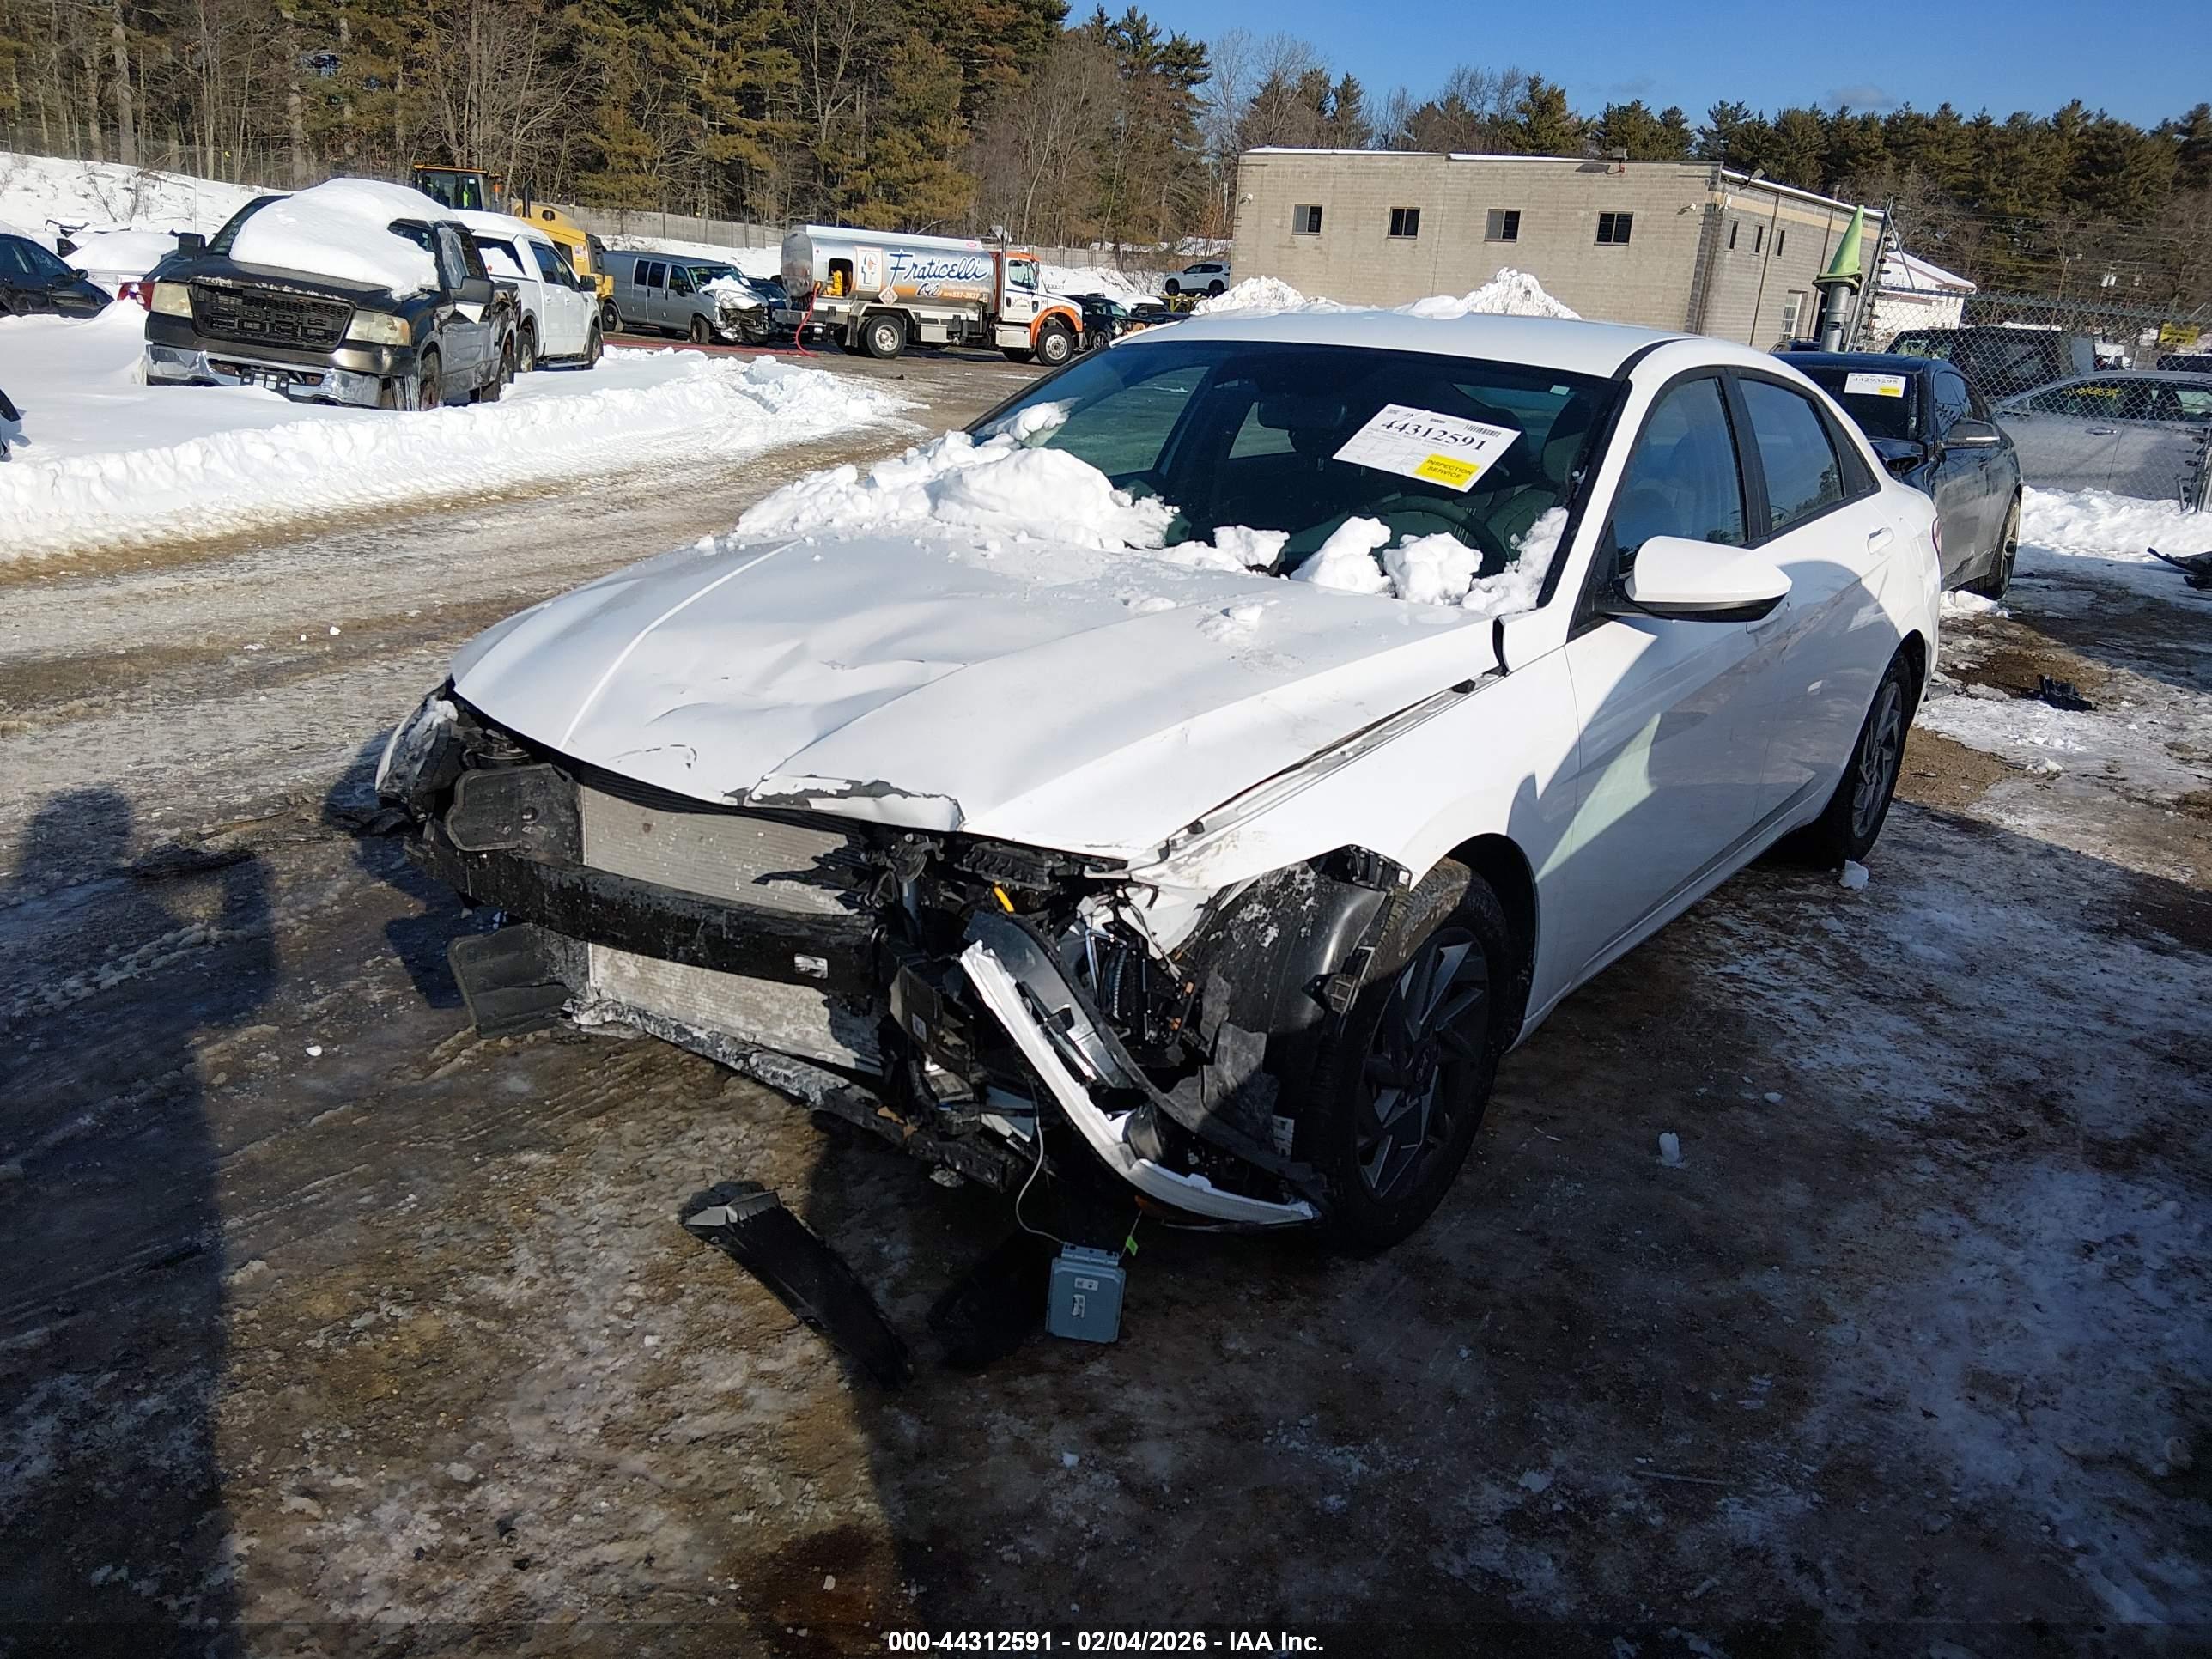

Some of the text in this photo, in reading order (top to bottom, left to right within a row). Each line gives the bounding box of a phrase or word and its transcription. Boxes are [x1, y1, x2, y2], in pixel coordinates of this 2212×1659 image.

[888, 249, 989, 288] Fraticelli
[916, 282, 943, 297] Oil
[1381, 420, 1488, 452] 44312591
[1426, 459, 1474, 476] INSPECTION
[1427, 465, 1463, 478] SERVICE
